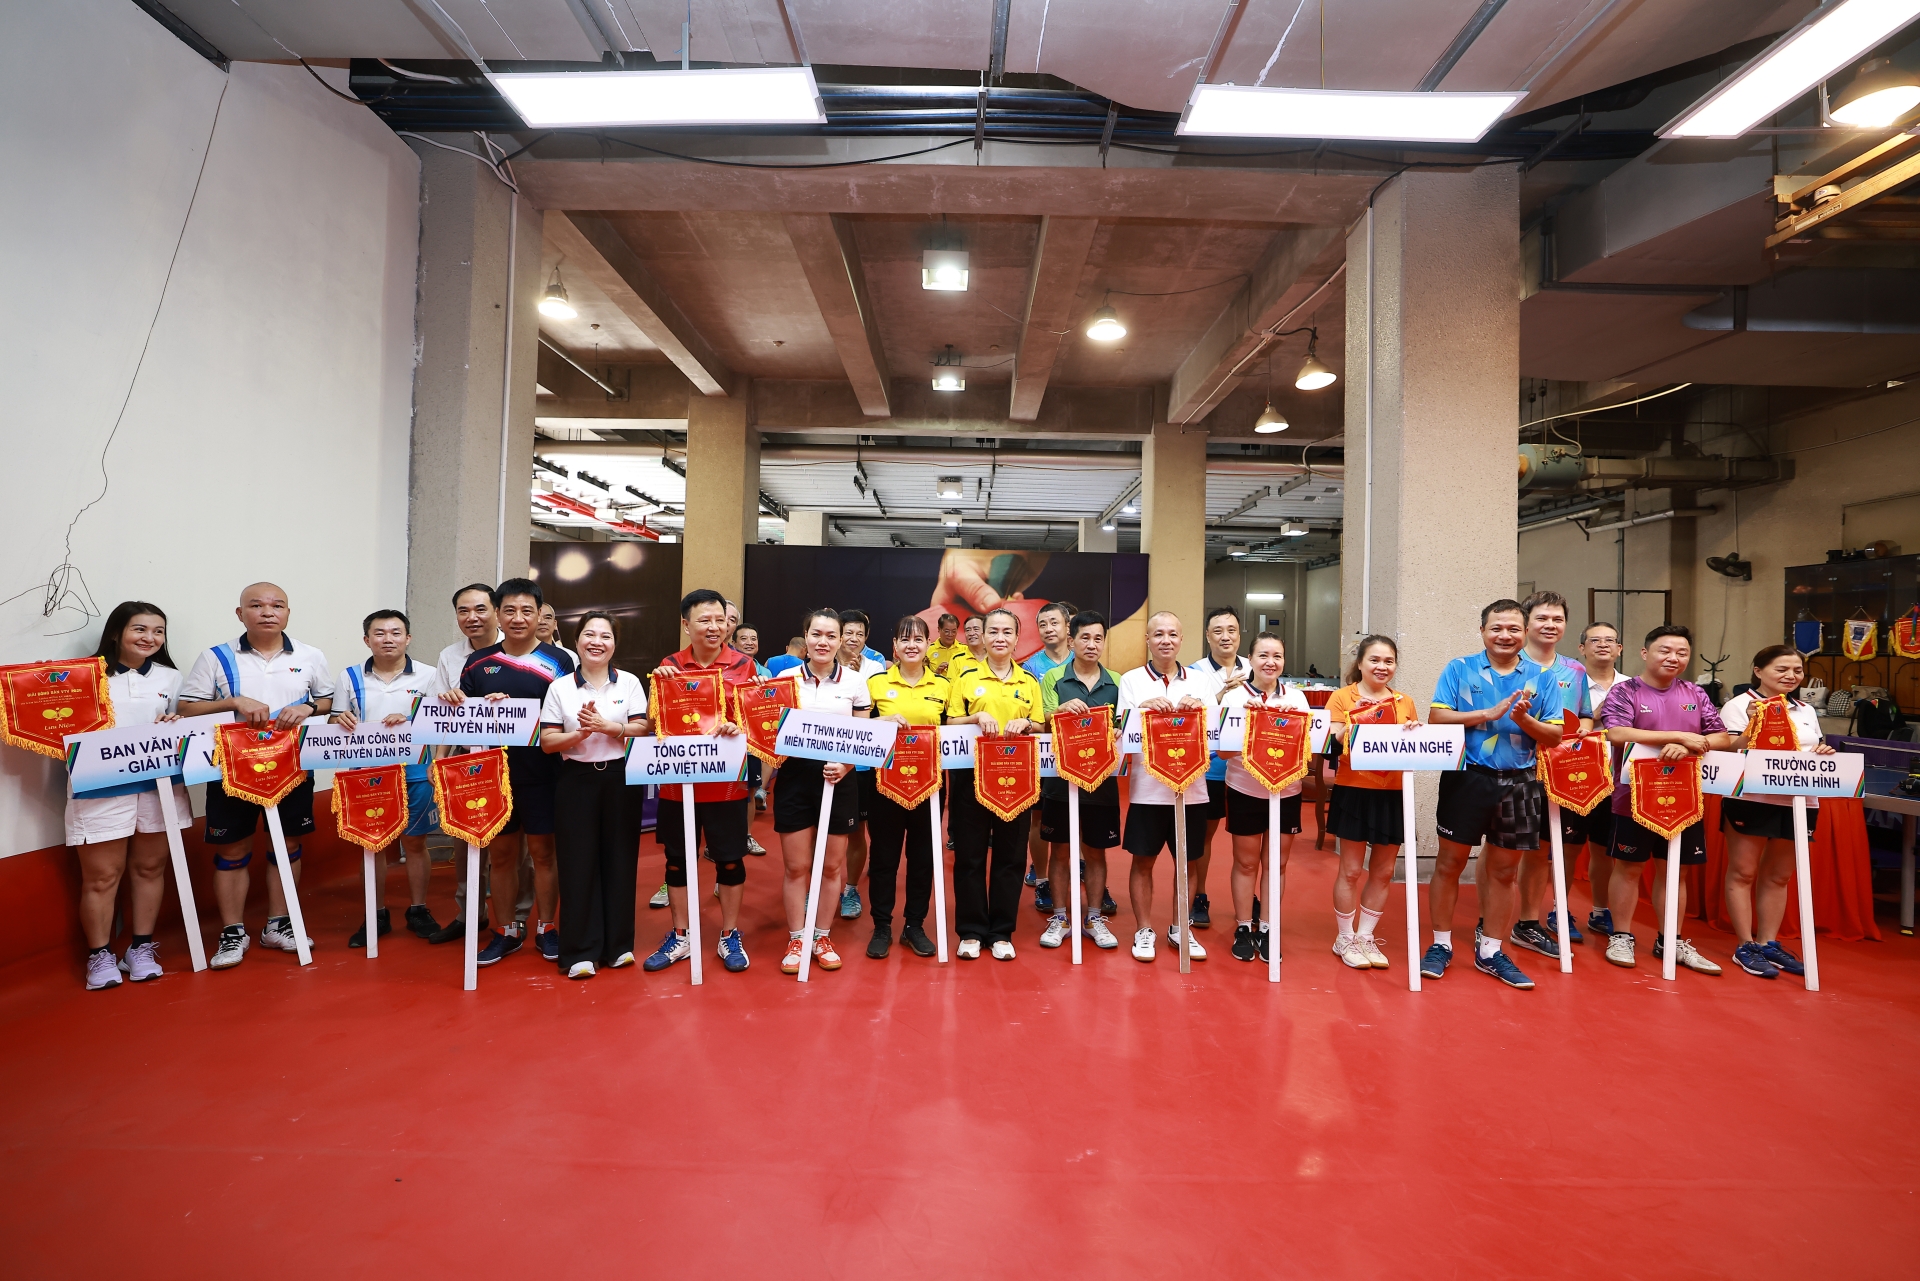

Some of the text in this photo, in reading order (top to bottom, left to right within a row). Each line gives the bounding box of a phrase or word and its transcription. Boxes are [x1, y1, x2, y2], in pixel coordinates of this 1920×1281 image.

[483, 666, 501, 675] VTV
[34, 671, 70, 684] VTV
[676, 681, 700, 691] VTV
[755, 688, 777, 699] VTV
[423, 704, 527, 719] TRUNG TÂM PHIM
[1680, 703, 1697, 711] VTV
[434, 719, 515, 734] TRUYỀN HÌNH
[1072, 717, 1093, 729] VTV
[1164, 717, 1185, 727] VTV
[1229, 716, 1242, 727] TT
[1268, 716, 1289, 727] VTV
[246, 730, 274, 741] VTV
[802, 722, 873, 743] TT THVN KHU VỰC
[306, 732, 412, 747] TRUNG TÂM CÔNG NG
[897, 735, 919, 744] VTV
[952, 735, 969, 755] TÀI
[100, 743, 136, 760] BAN
[139, 736, 173, 754] VĂN
[688, 744, 718, 757] CTTH
[806, 738, 834, 752] TRUNG
[836, 741, 852, 754] TÂY
[852, 744, 886, 759] NGUYÊN
[996, 746, 1017, 755] VTV
[1039, 742, 1051, 753] TT
[1363, 738, 1453, 756] BAN VĂN NGHỆ
[323, 750, 331, 760] &
[128, 755, 161, 774] GIẢI
[164, 754, 181, 767] TR
[673, 760, 698, 777] VIỆT
[701, 761, 726, 774] NAM
[1040, 755, 1056, 769] MỸ
[1765, 756, 1837, 772] TRƯỜNG CĐ
[460, 764, 483, 777] VTV
[1654, 766, 1676, 775] VTV
[1701, 764, 1720, 785] SỰ
[359, 776, 383, 788] VTV
[1762, 773, 1840, 789] TRUYỀN HÌNH
[1617, 843, 1637, 853] VTV
